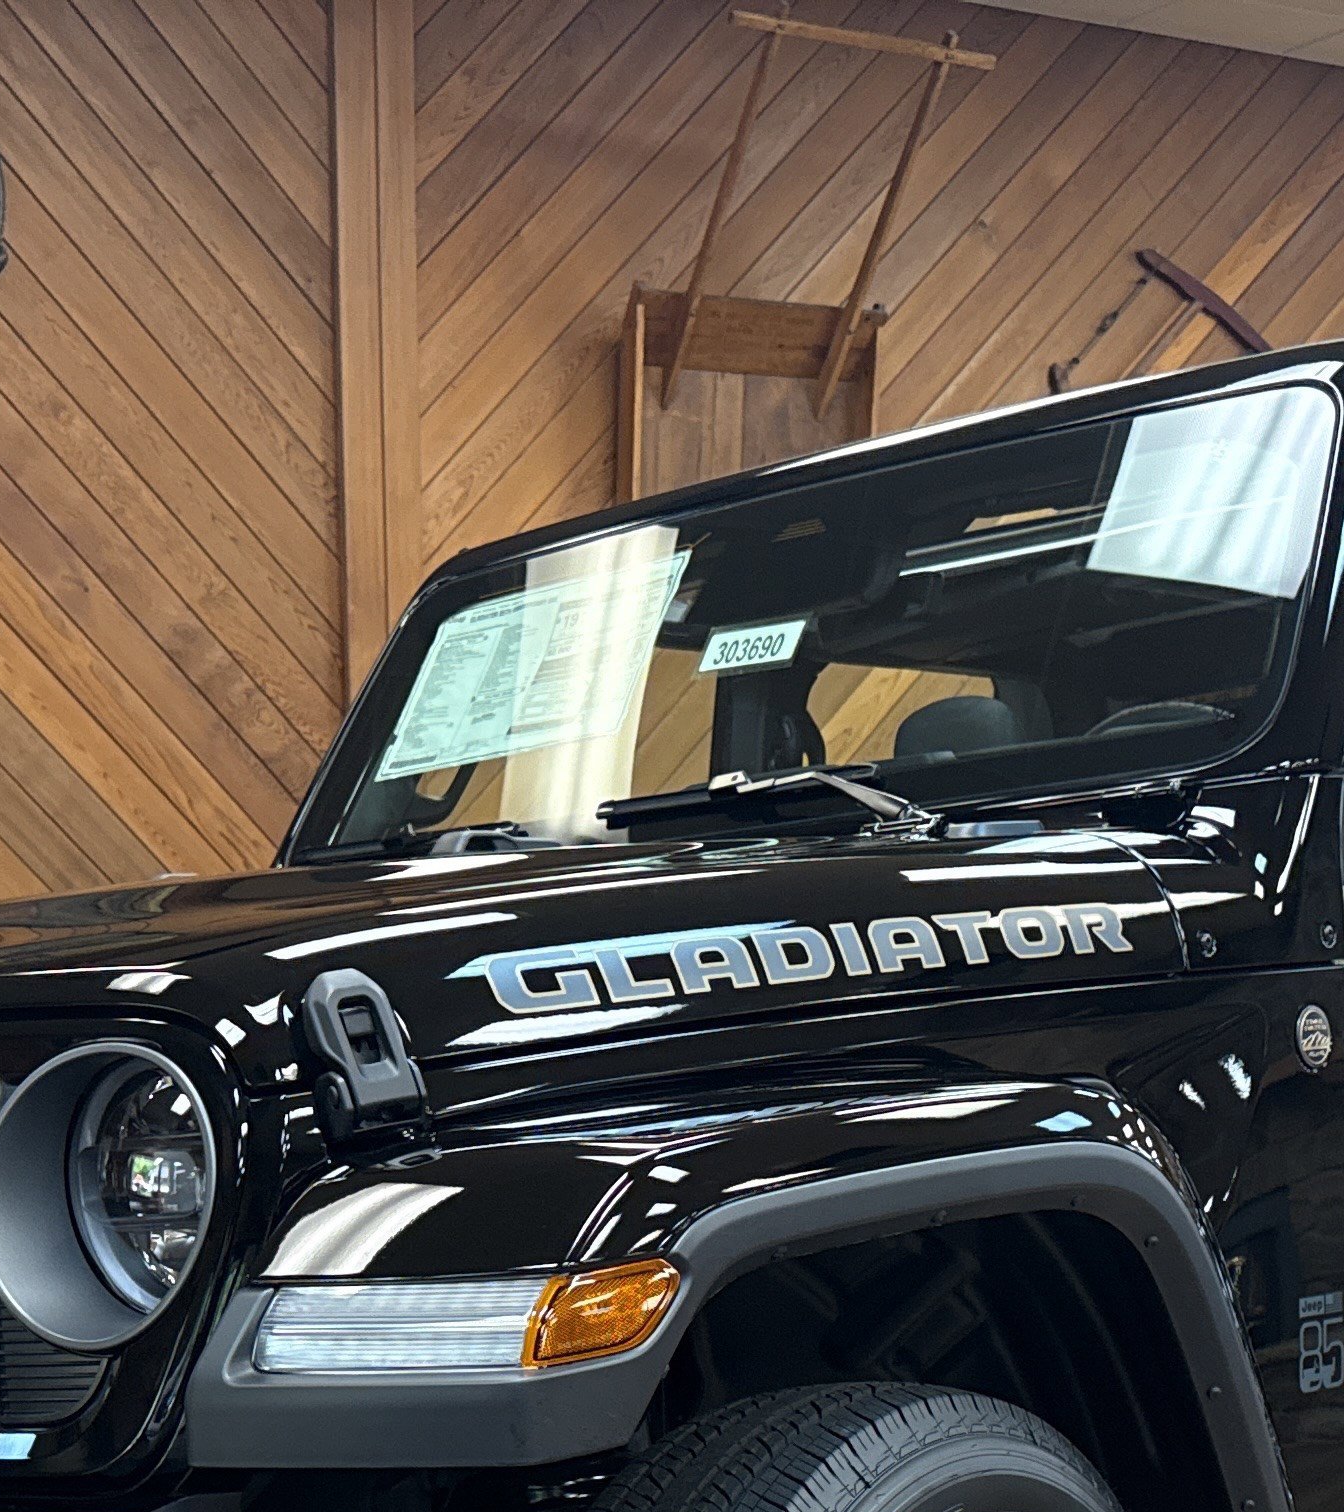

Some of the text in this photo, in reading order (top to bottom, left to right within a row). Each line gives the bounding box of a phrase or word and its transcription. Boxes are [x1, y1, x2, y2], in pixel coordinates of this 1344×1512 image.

[713, 633, 785, 665] 303690
[481, 902, 1134, 1015] GLADIATOR
[1302, 1301, 1323, 1314] Jeep
[1299, 1316, 1344, 1393] 85
